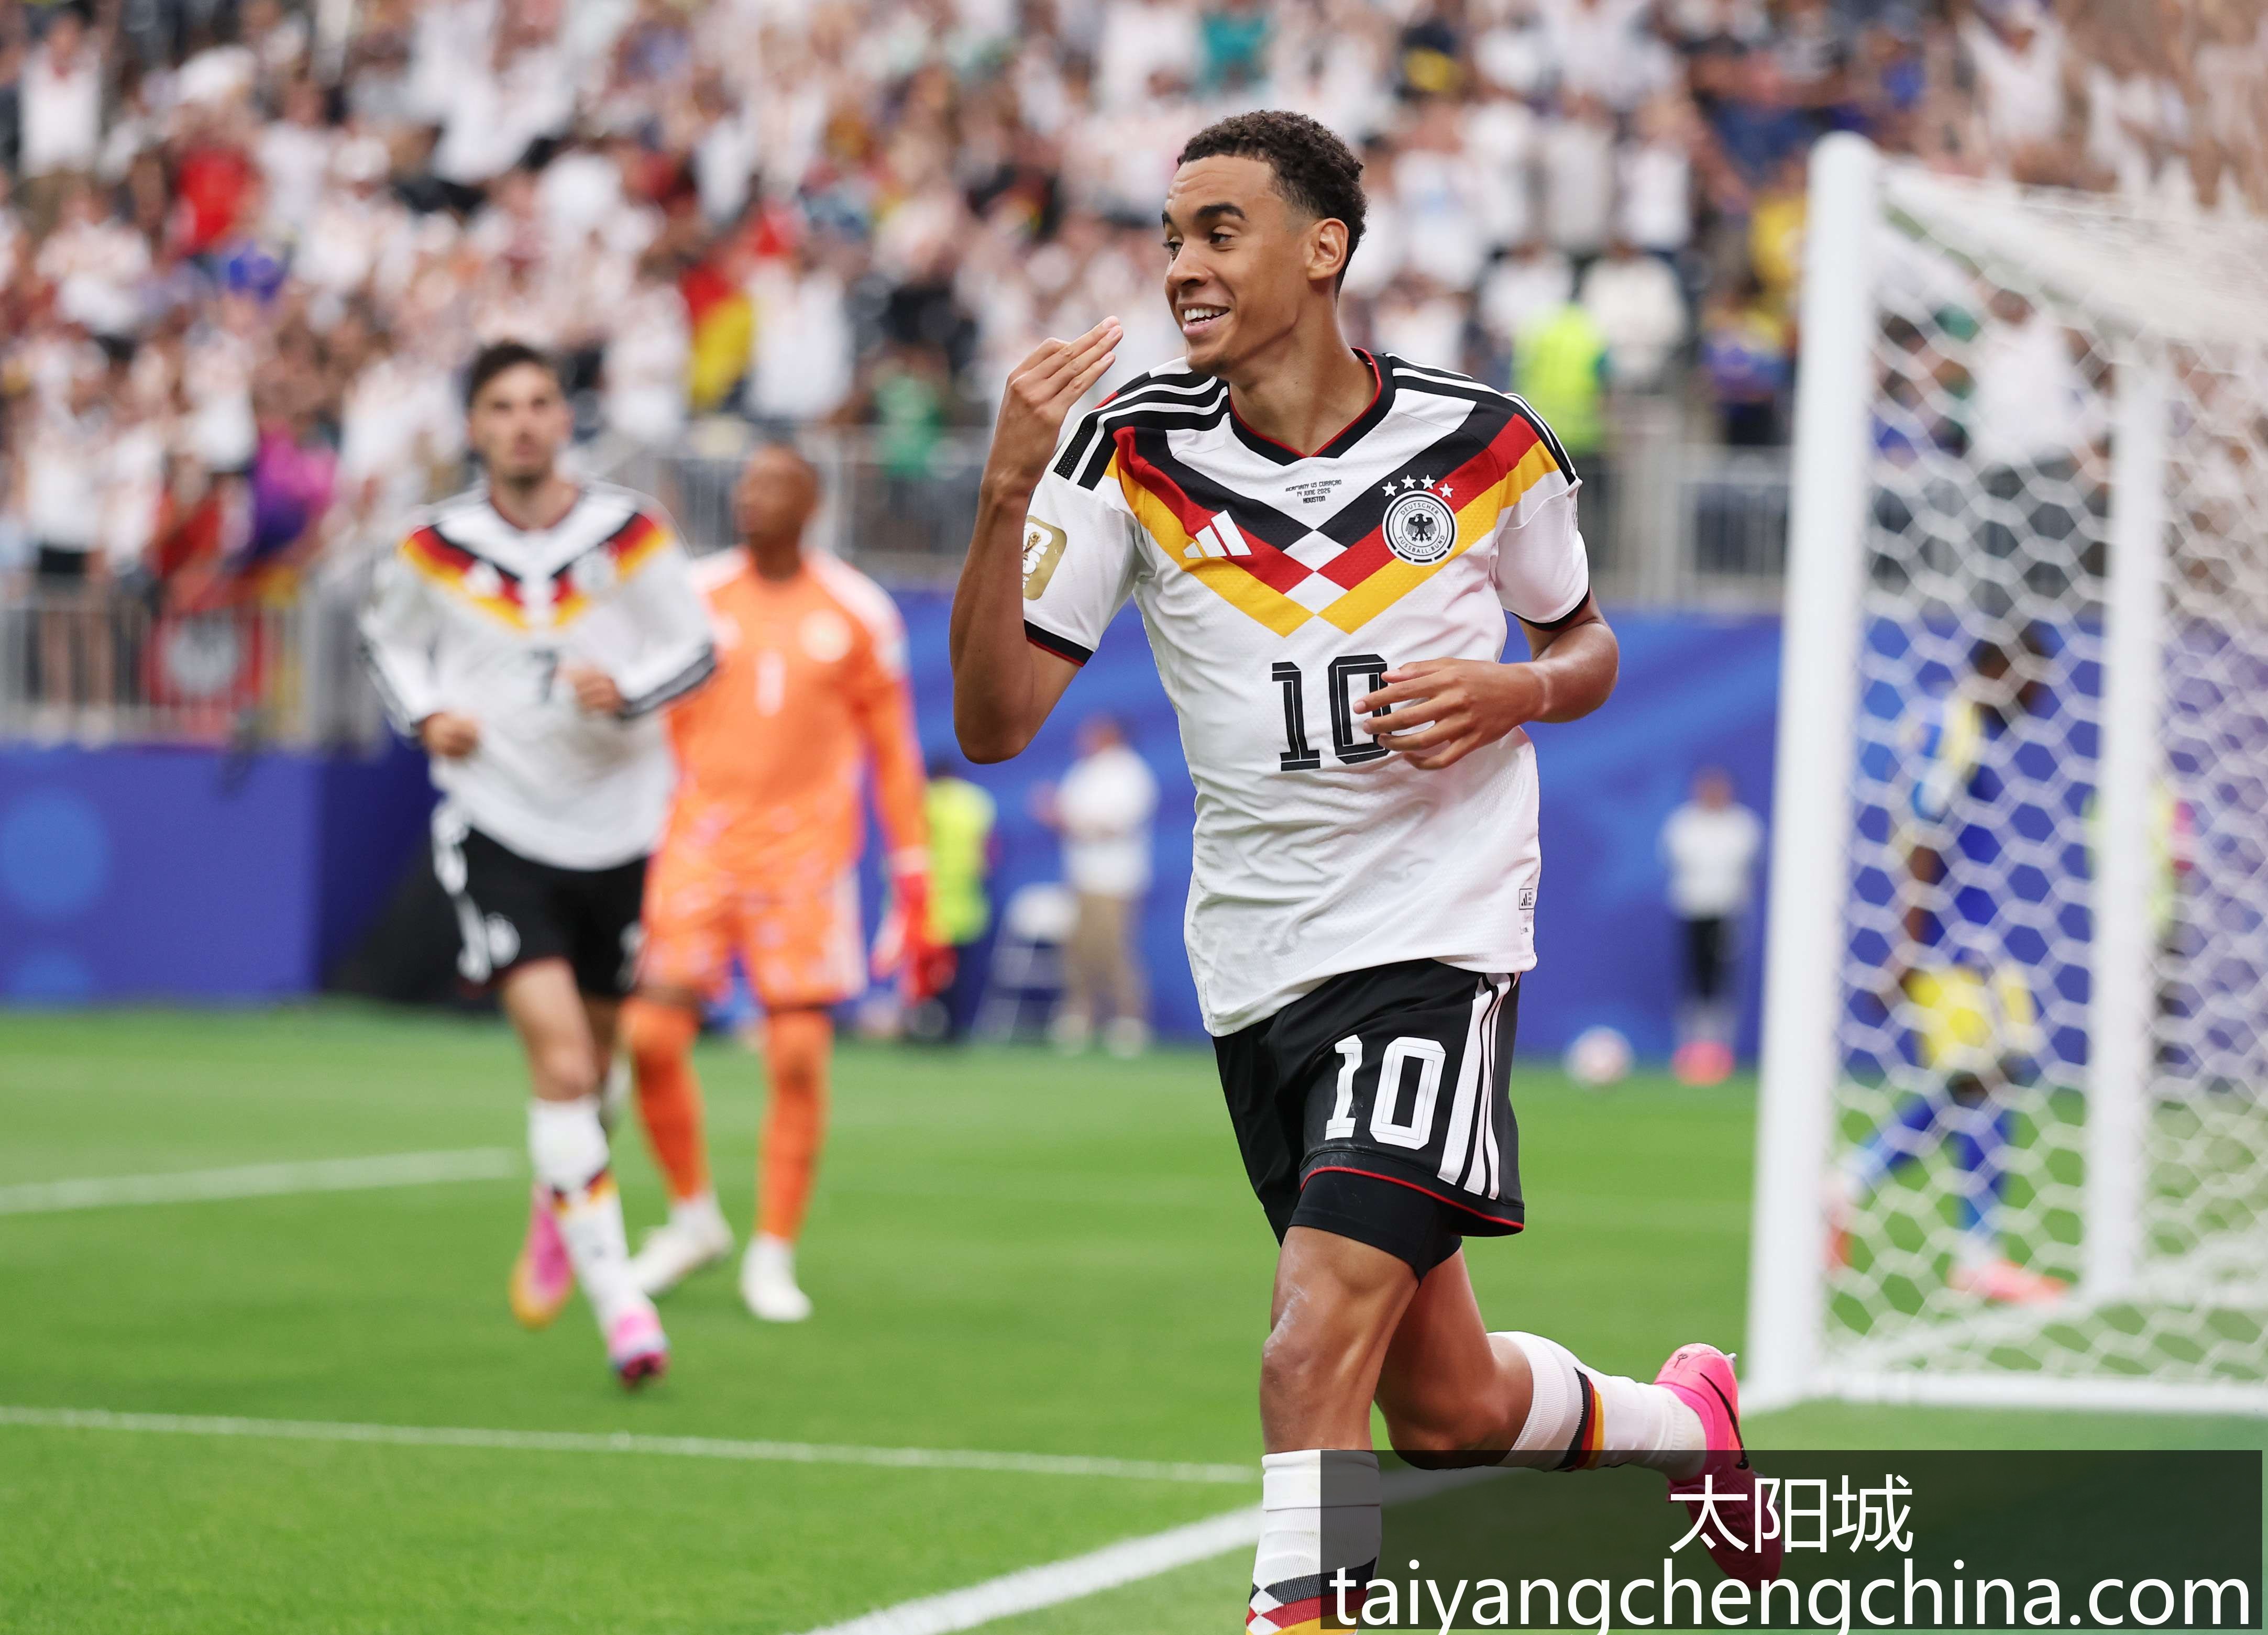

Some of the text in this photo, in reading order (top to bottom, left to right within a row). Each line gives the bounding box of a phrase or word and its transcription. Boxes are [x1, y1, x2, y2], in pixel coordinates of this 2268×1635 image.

[1285, 483, 1309, 492] GERMANY
[1303, 495, 1326, 504] HOUSTON
[1400, 503, 1439, 515] DEUTSCHER
[1272, 654, 1393, 771] 10
[1325, 1034, 1446, 1150] 10
